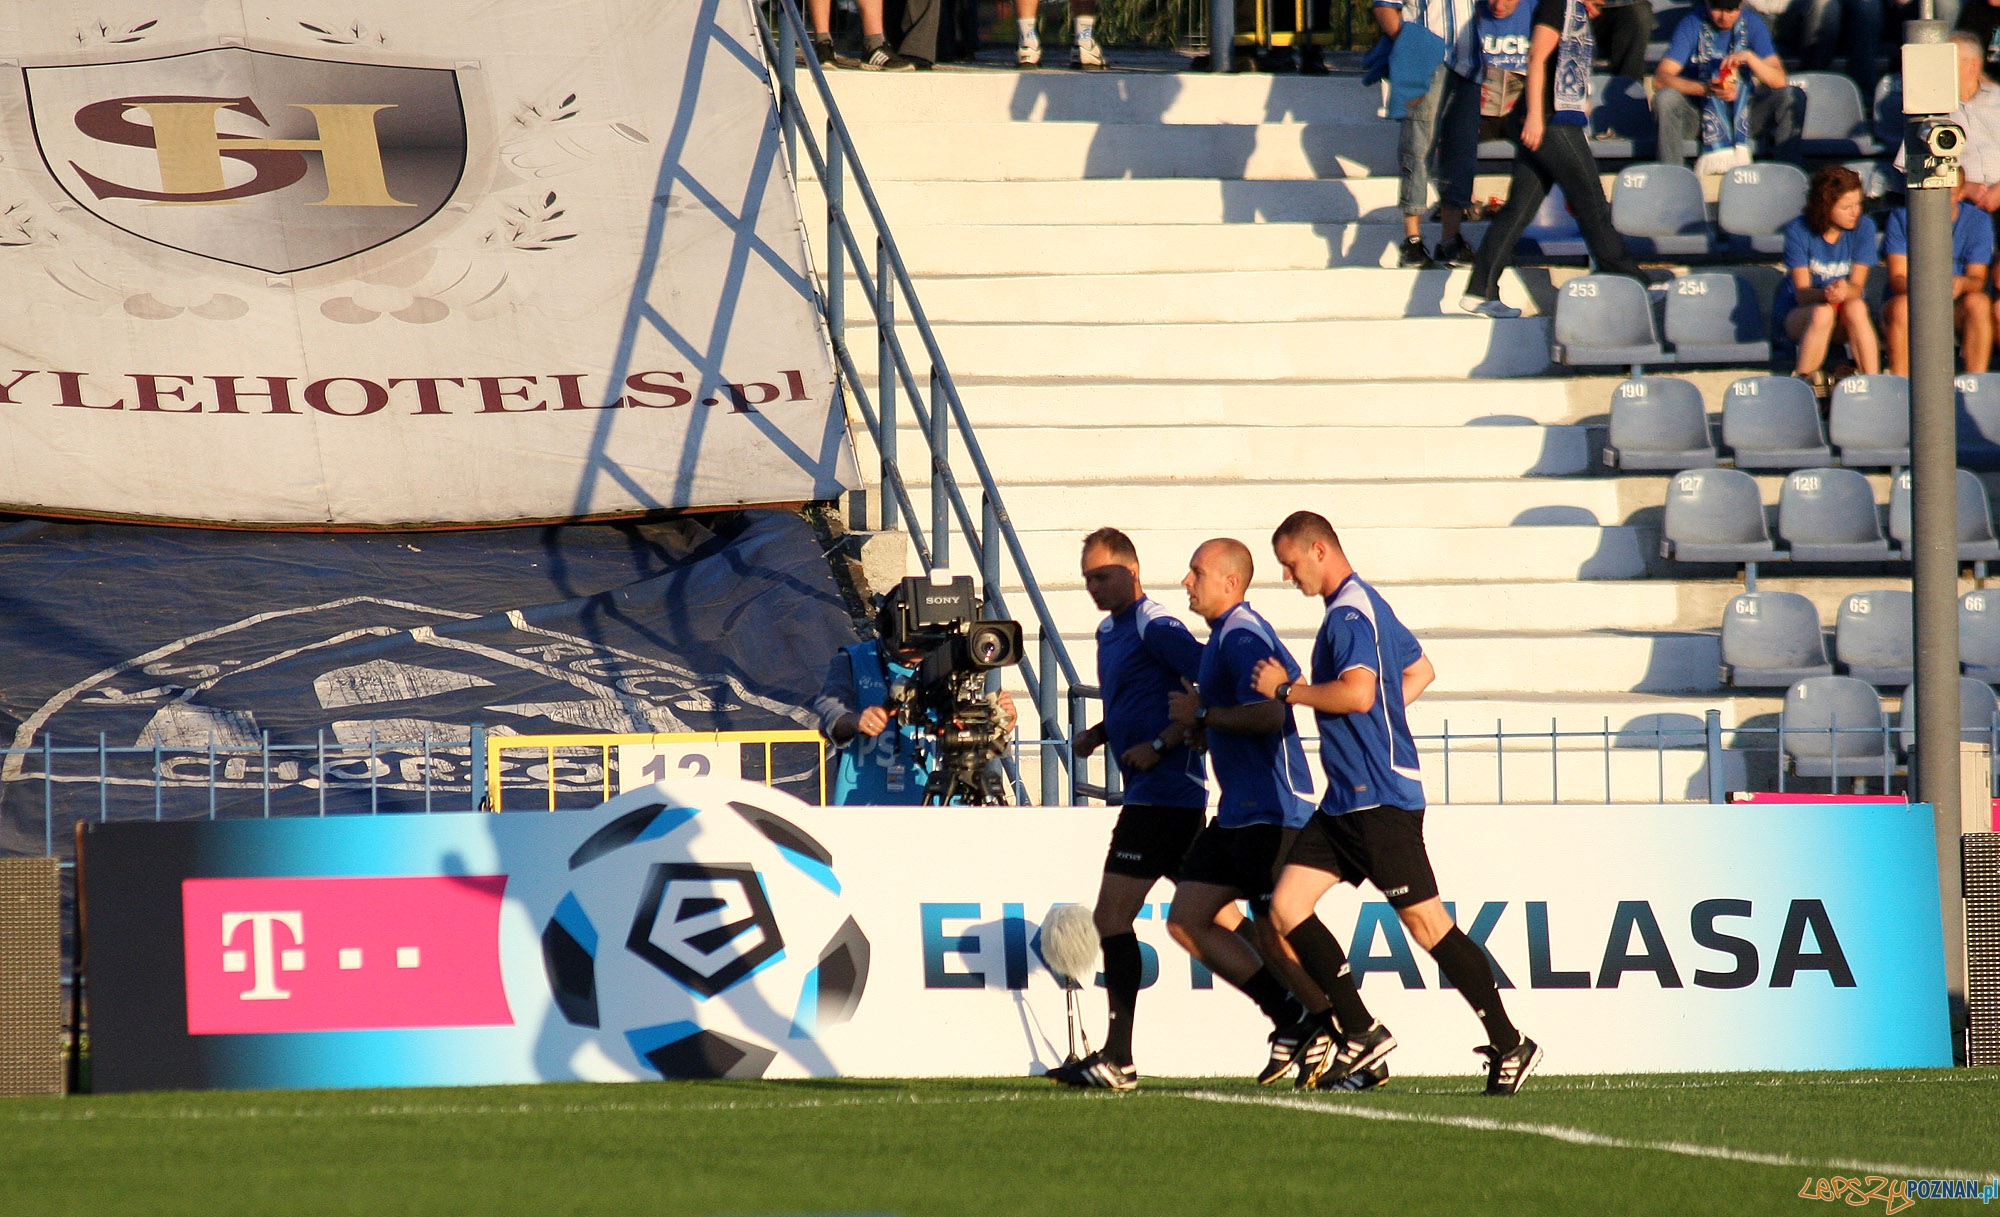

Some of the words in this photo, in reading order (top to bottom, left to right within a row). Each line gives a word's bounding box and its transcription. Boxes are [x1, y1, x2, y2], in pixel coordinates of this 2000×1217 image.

[1482, 36, 1530, 55] UCH
[1623, 174, 1646, 189] 317
[1568, 283, 1597, 297] 253
[1678, 281, 1707, 295] 254
[1620, 383, 1645, 398] 190
[1733, 381, 1758, 396] 191
[1841, 379, 1868, 394] 192
[1678, 477, 1703, 491] 127
[1793, 476, 1819, 491] 128
[926, 596, 960, 605] SONY
[1735, 600, 1756, 615] 64
[1849, 598, 1870, 614] 65
[1965, 596, 1983, 611] 66
[1797, 684, 1807, 699] 1
[642, 753, 711, 783] 12
